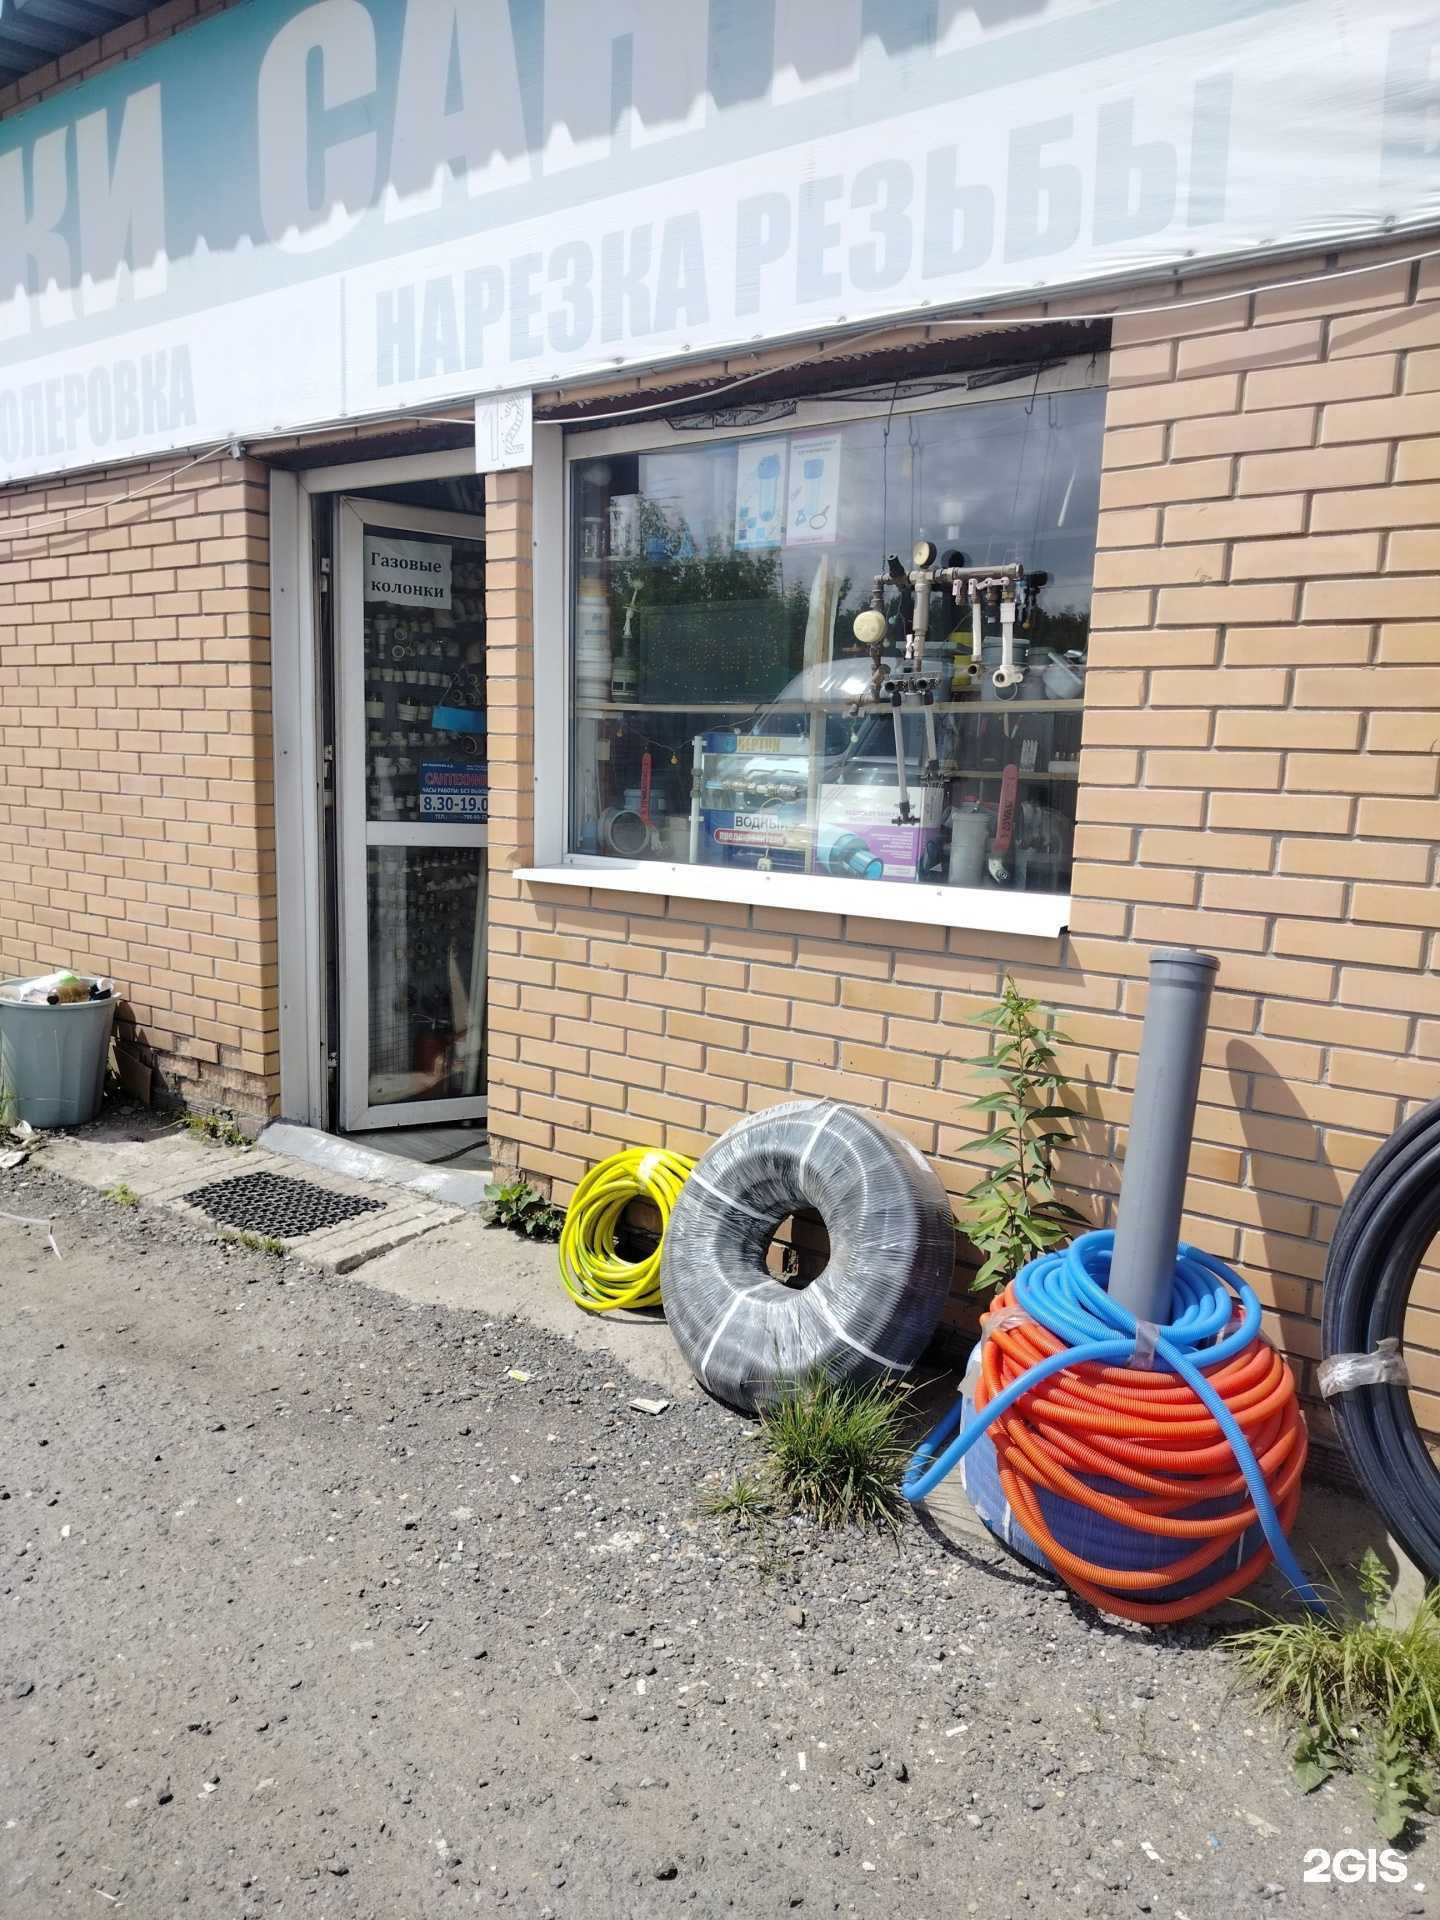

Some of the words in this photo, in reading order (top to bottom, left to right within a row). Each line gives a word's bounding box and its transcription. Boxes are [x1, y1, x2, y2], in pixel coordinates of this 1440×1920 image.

[376, 209, 710, 389] НАРЕЗКА
[734, 72, 1234, 318] РЕЗЬБЫ
[371, 551, 442, 573] Газовые
[371, 580, 444, 598] колонки
